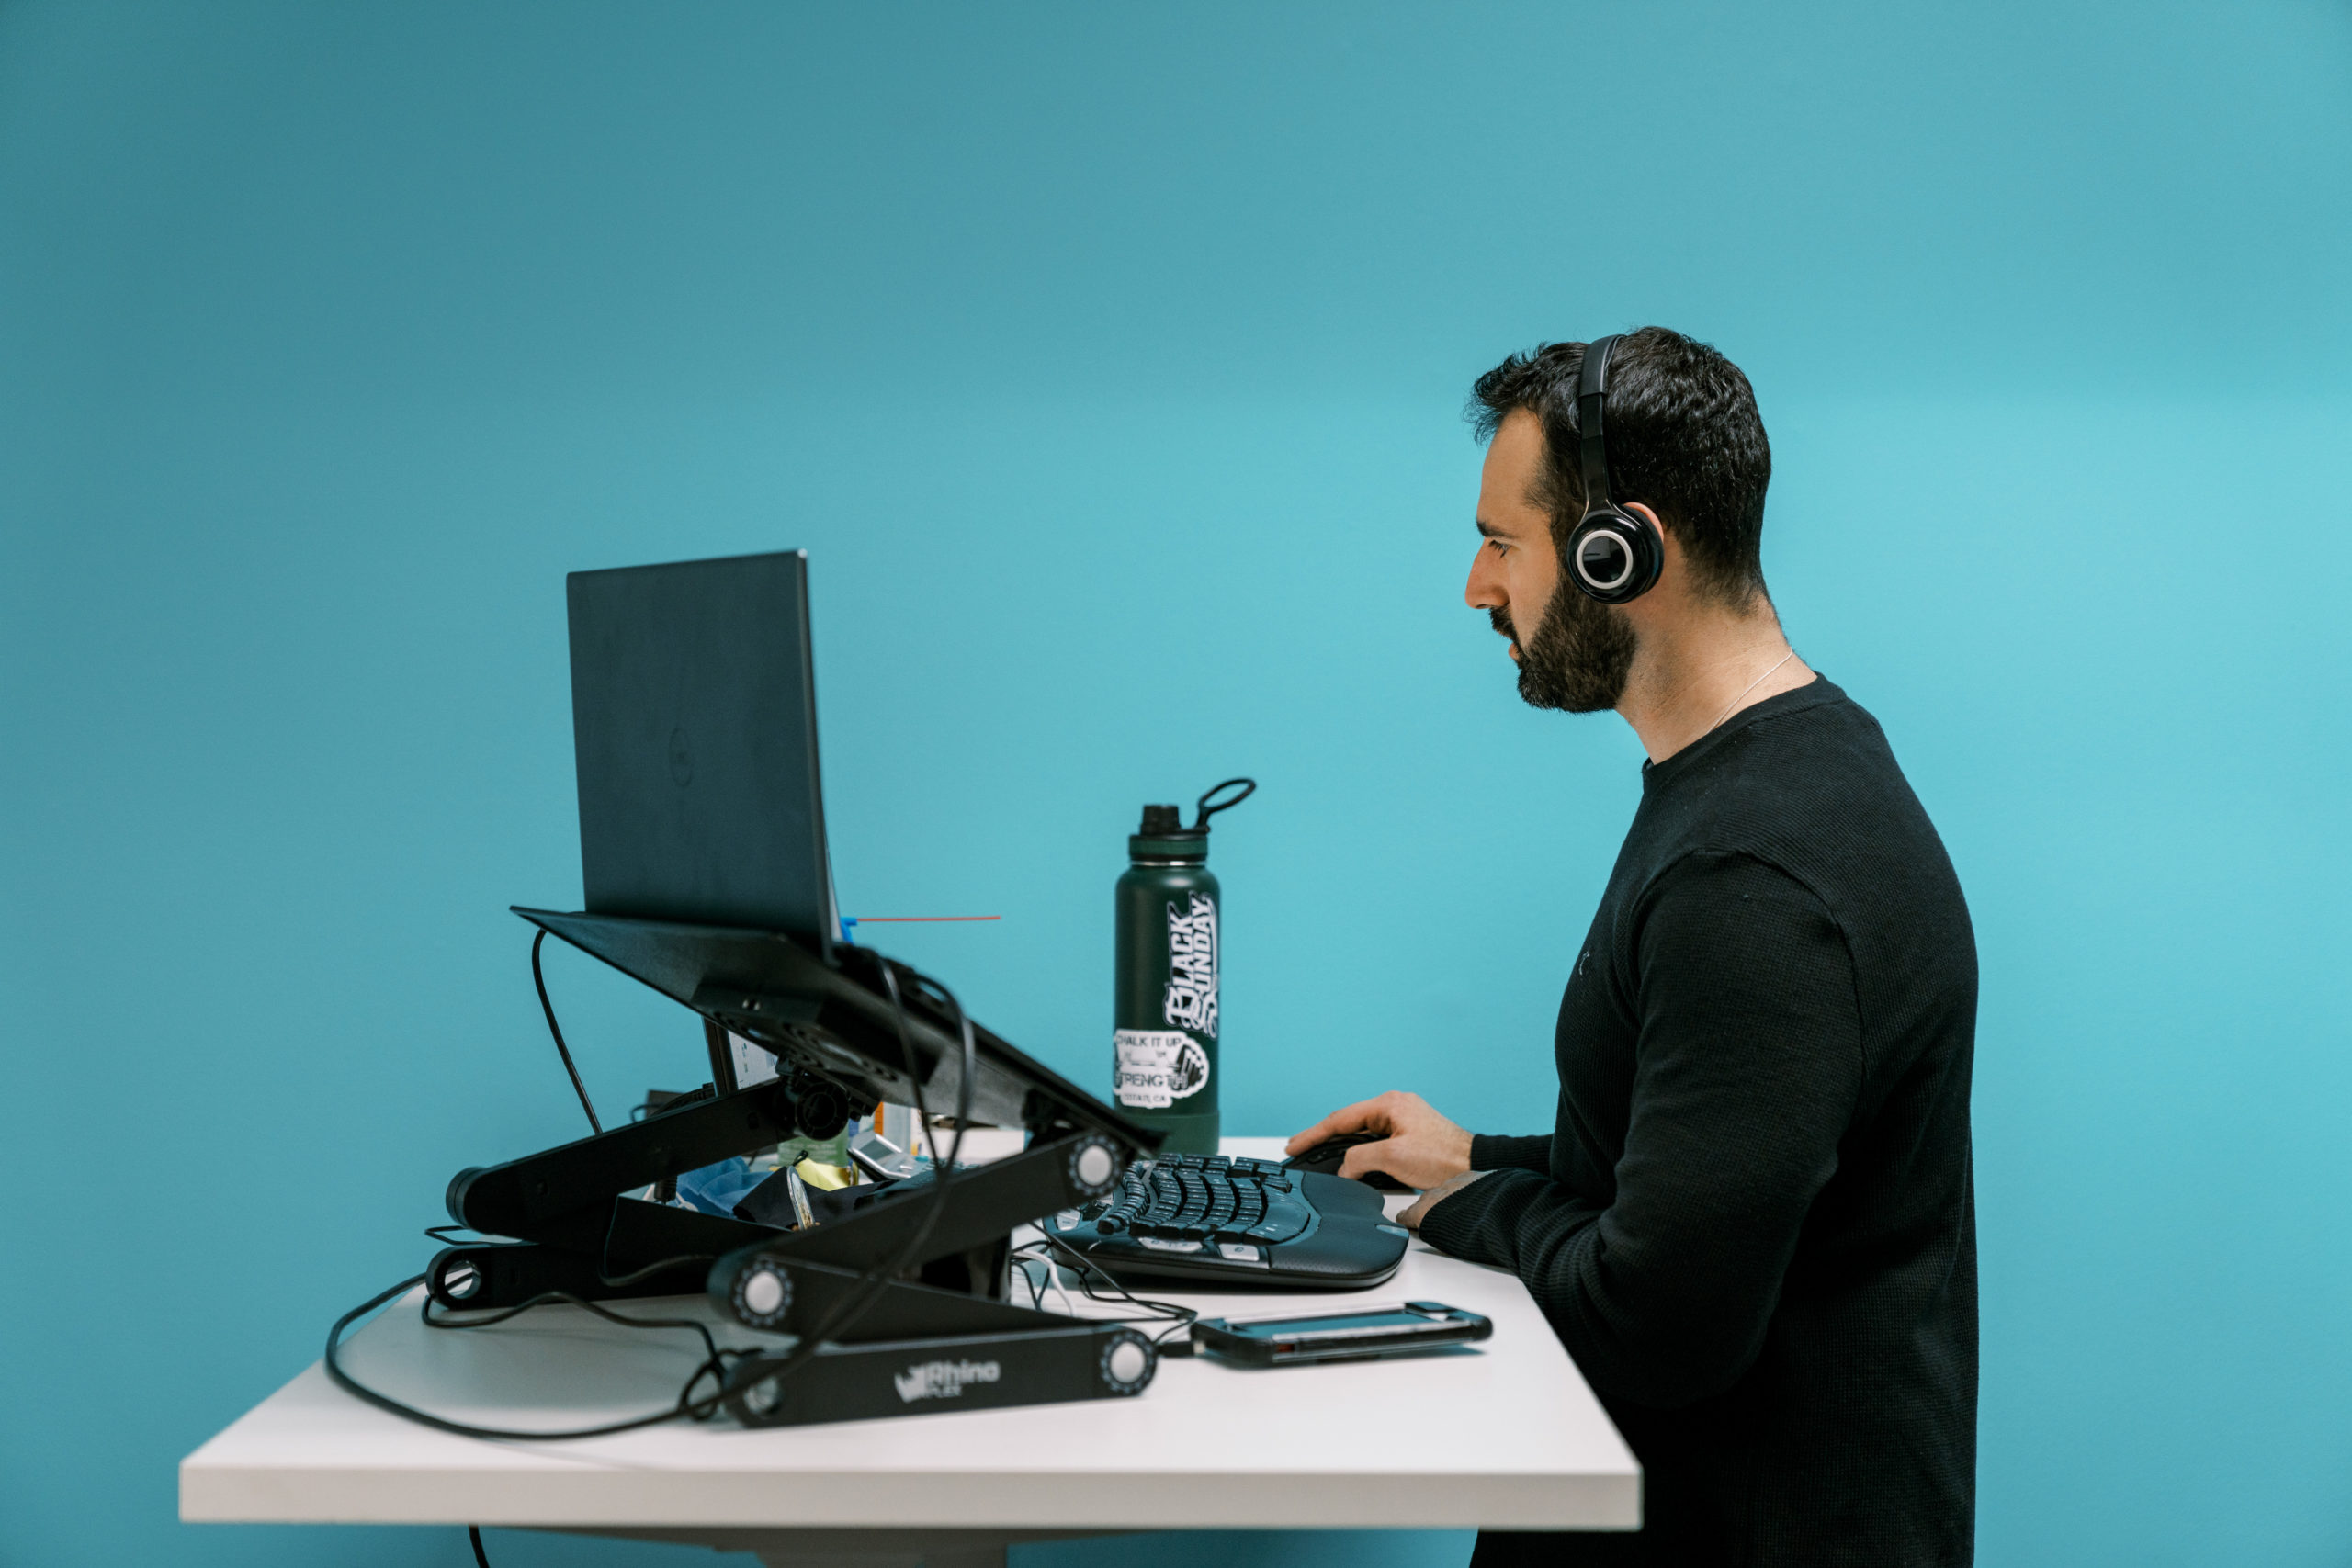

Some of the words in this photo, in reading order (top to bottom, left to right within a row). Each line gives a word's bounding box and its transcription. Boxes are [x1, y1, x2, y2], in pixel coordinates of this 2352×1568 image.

[1164, 904, 1200, 1027] BLACK
[1193, 896, 1218, 1037] SUNDAY
[1151, 1037, 1162, 1047] IT
[1165, 1037, 1182, 1047] UP
[924, 1359, 1001, 1388] Rhino
